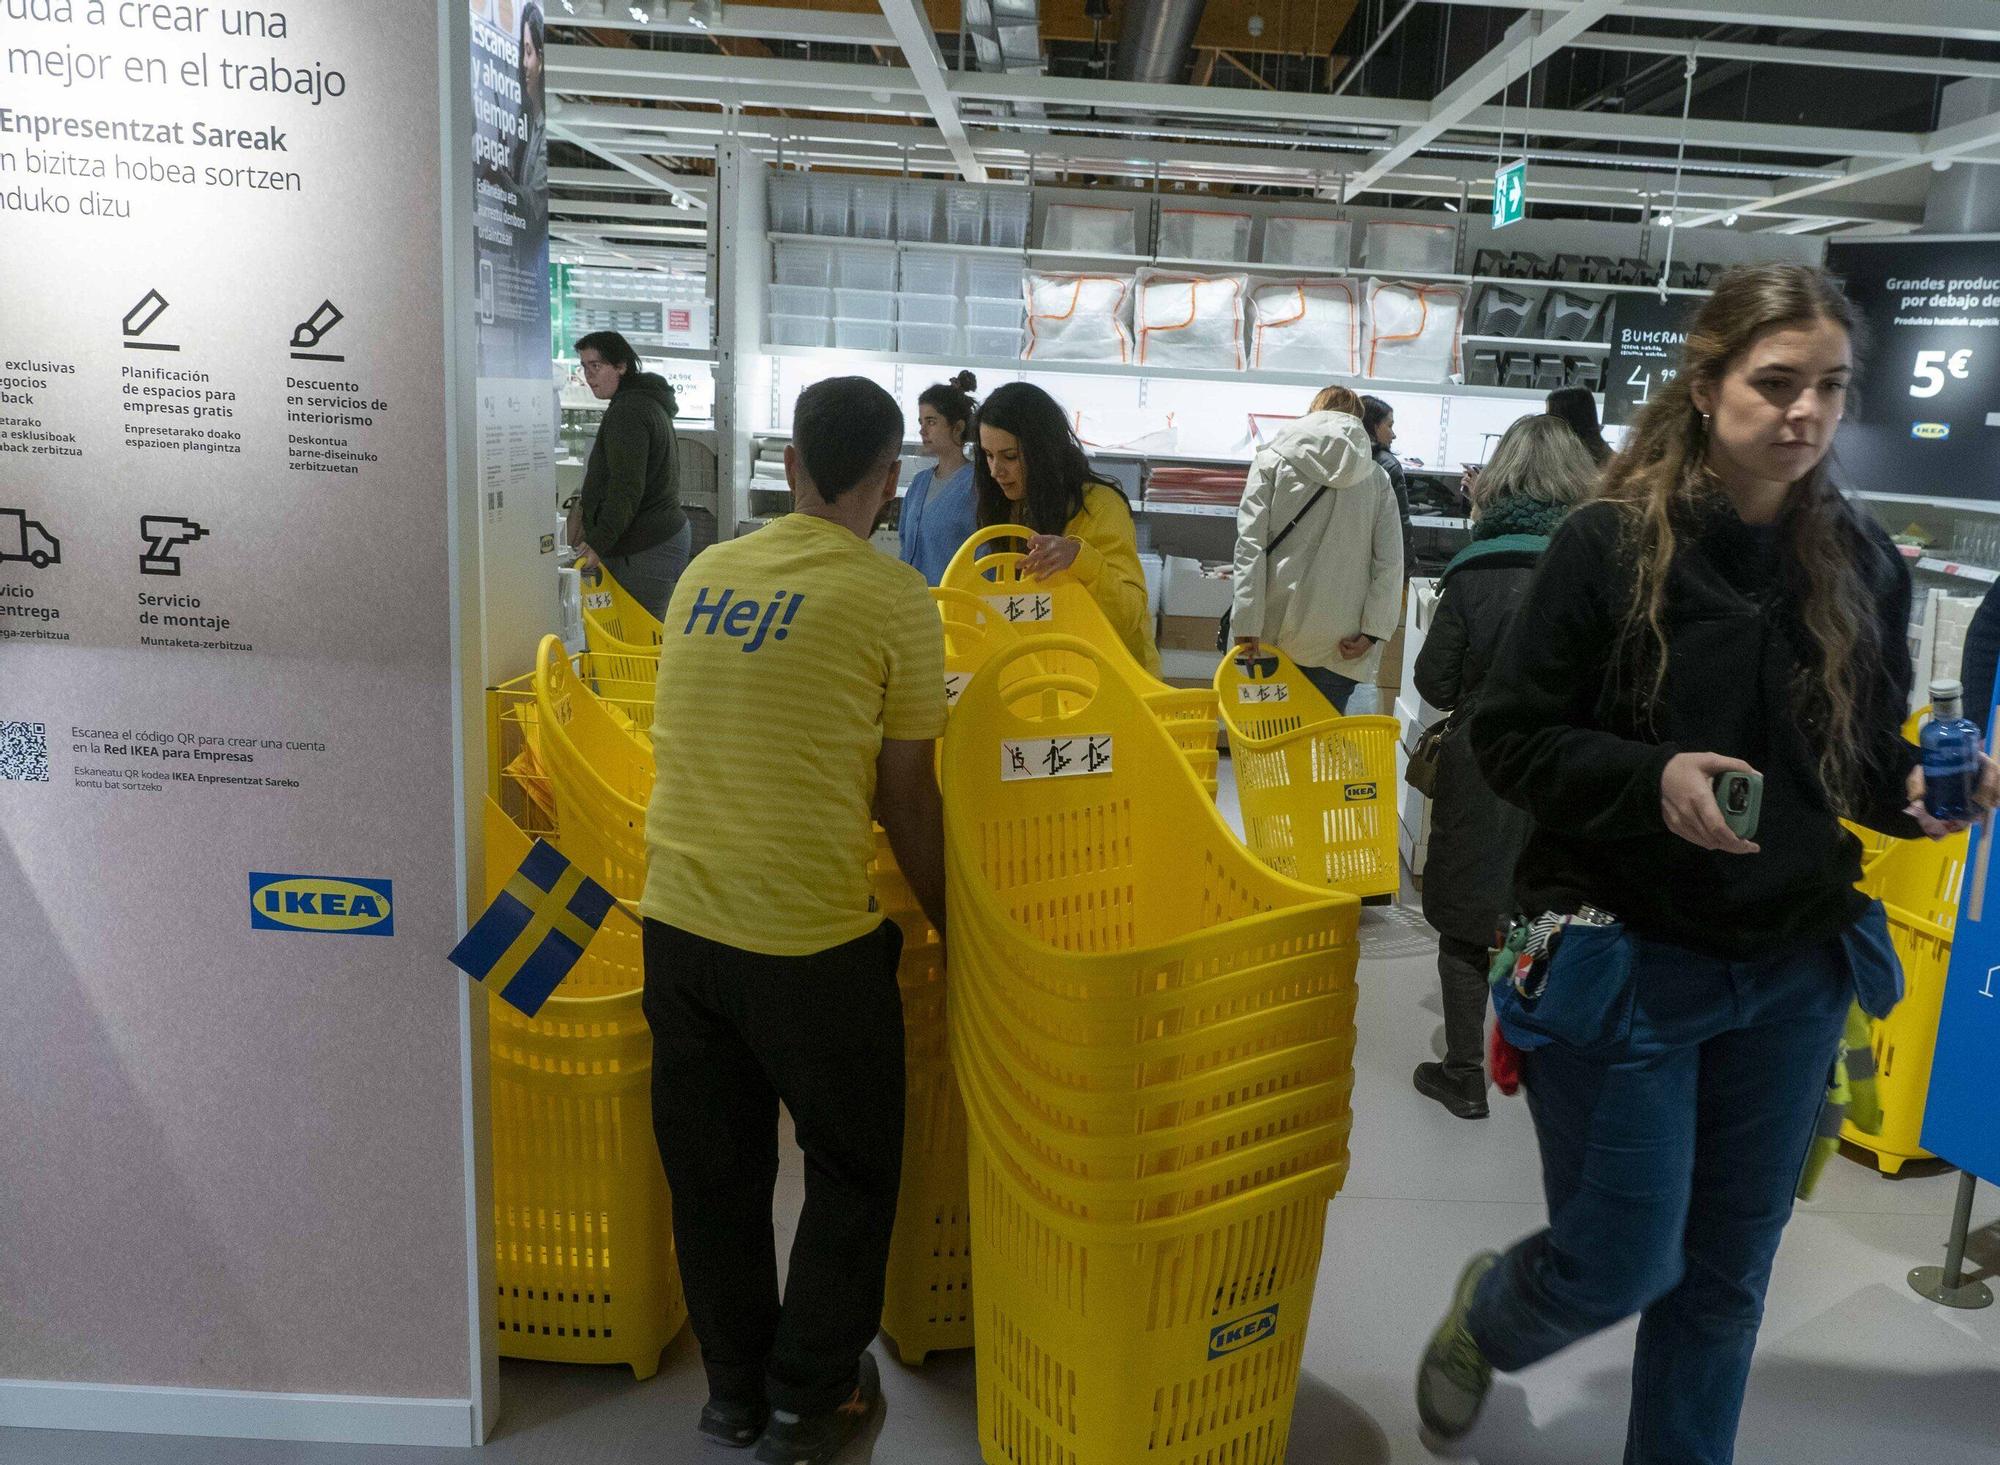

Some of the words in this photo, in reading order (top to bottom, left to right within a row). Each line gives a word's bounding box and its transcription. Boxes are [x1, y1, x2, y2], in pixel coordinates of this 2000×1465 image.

[0, 0, 72, 23] uda
[87, 0, 105, 25] a
[119, 2, 208, 32] crear
[222, 9, 287, 38] una
[471, 19, 519, 69] Escanea
[9, 44, 112, 87] mejor
[125, 57, 166, 84] en
[181, 52, 208, 87] el
[220, 57, 345, 105] trabajo
[472, 56, 480, 89] y
[483, 59, 522, 104] ahorra
[473, 91, 516, 140] tiempo
[518, 113, 528, 142] al
[0, 108, 184, 144] Enpresentzat
[192, 122, 288, 152] Sareak
[475, 132, 510, 171] pagar
[26, 147, 105, 177] bizitza
[116, 153, 195, 184] hobea
[205, 166, 301, 191] sortzen
[80, 190, 130, 218] dizu
[1886, 277, 1945, 290] Grandes
[1947, 277, 2000, 293] produc
[1901, 296, 1927, 310] por
[1929, 294, 1979, 311] debajo
[1982, 294, 2000, 307] de
[5, 360, 75, 374] exclusivas
[121, 366, 209, 383] Planificación
[1909, 349, 1973, 398] 5€
[0, 377, 47, 389] gocios
[286, 377, 359, 392] Descuento
[1, 392, 34, 404] back
[122, 383, 139, 394] de
[143, 386, 201, 399] espacios
[205, 390, 236, 402] para
[123, 402, 190, 415] empresas
[193, 406, 233, 418] gratis
[287, 396, 303, 405] en
[307, 397, 367, 410] servicios
[371, 399, 388, 411] de
[287, 410, 373, 426] interiorismo
[11, 431, 76, 442] esklusiboak
[125, 424, 204, 438] Enpresetarako
[207, 429, 241, 440] doako
[288, 434, 348, 447] Deskontua
[0, 442, 29, 453] back
[32, 445, 83, 456] zerbitzua
[125, 439, 180, 449] espazioen
[183, 441, 241, 453] plangintza
[289, 447, 378, 462] barne-diseinuko
[289, 462, 359, 473] zerbitzuetan
[138, 592, 201, 608] Servicio
[0, 605, 60, 621] entrega
[139, 611, 159, 624] de
[164, 616, 230, 632] montaje
[684, 586, 805, 653] Hej!
[141, 636, 253, 651] Muntaketa-zerbitzua
[71, 726, 119, 740] Escanea
[122, 729, 132, 740] el
[135, 731, 174, 745] código
[177, 733, 195, 744] QR
[199, 736, 225, 747] para
[228, 738, 257, 748] crear
[260, 740, 283, 749] una
[286, 741, 326, 752] cuenta
[73, 744, 88, 753] en
[90, 743, 100, 753] la
[104, 744, 127, 755] Red
[130, 745, 159, 756] IKEA
[163, 749, 190, 760] para
[194, 749, 254, 763] Empresas
[74, 766, 123, 778] Eskaneatu
[124, 769, 139, 779] QR
[141, 770, 170, 780] kodea
[172, 772, 195, 782] IKEA
[198, 774, 263, 786] Enpresentzat
[265, 777, 300, 788] Sareko
[75, 778, 102, 789] kontu
[104, 779, 119, 789] bat
[122, 782, 162, 792] sortzeko
[265, 890, 381, 918] IKEA
[1216, 1317, 1271, 1348] IKEA
